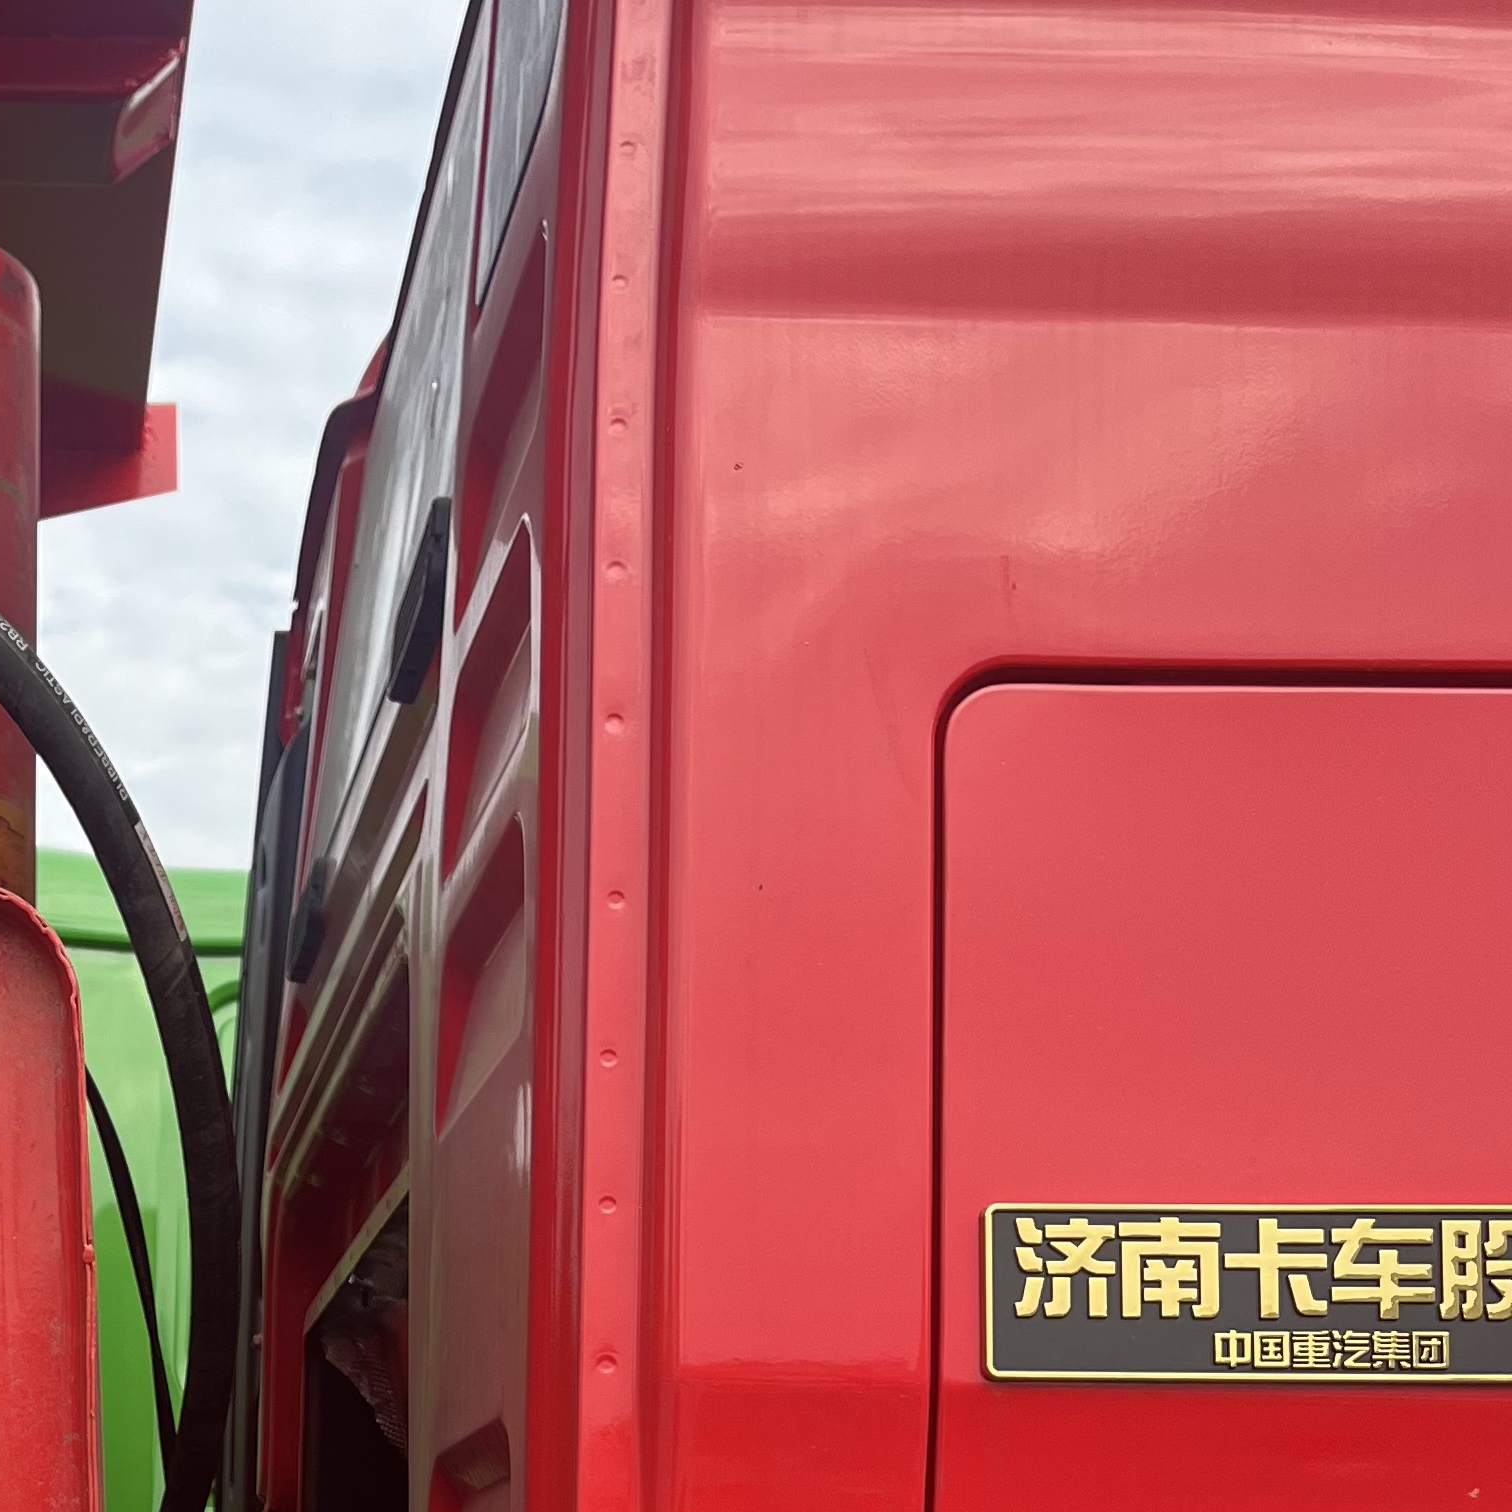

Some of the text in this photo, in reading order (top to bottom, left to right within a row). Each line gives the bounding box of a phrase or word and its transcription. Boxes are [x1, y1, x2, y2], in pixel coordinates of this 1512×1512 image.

[1014, 1217, 1512, 1320] 济南卡车股
[1214, 1329, 1450, 1369] 中国重汽集团
